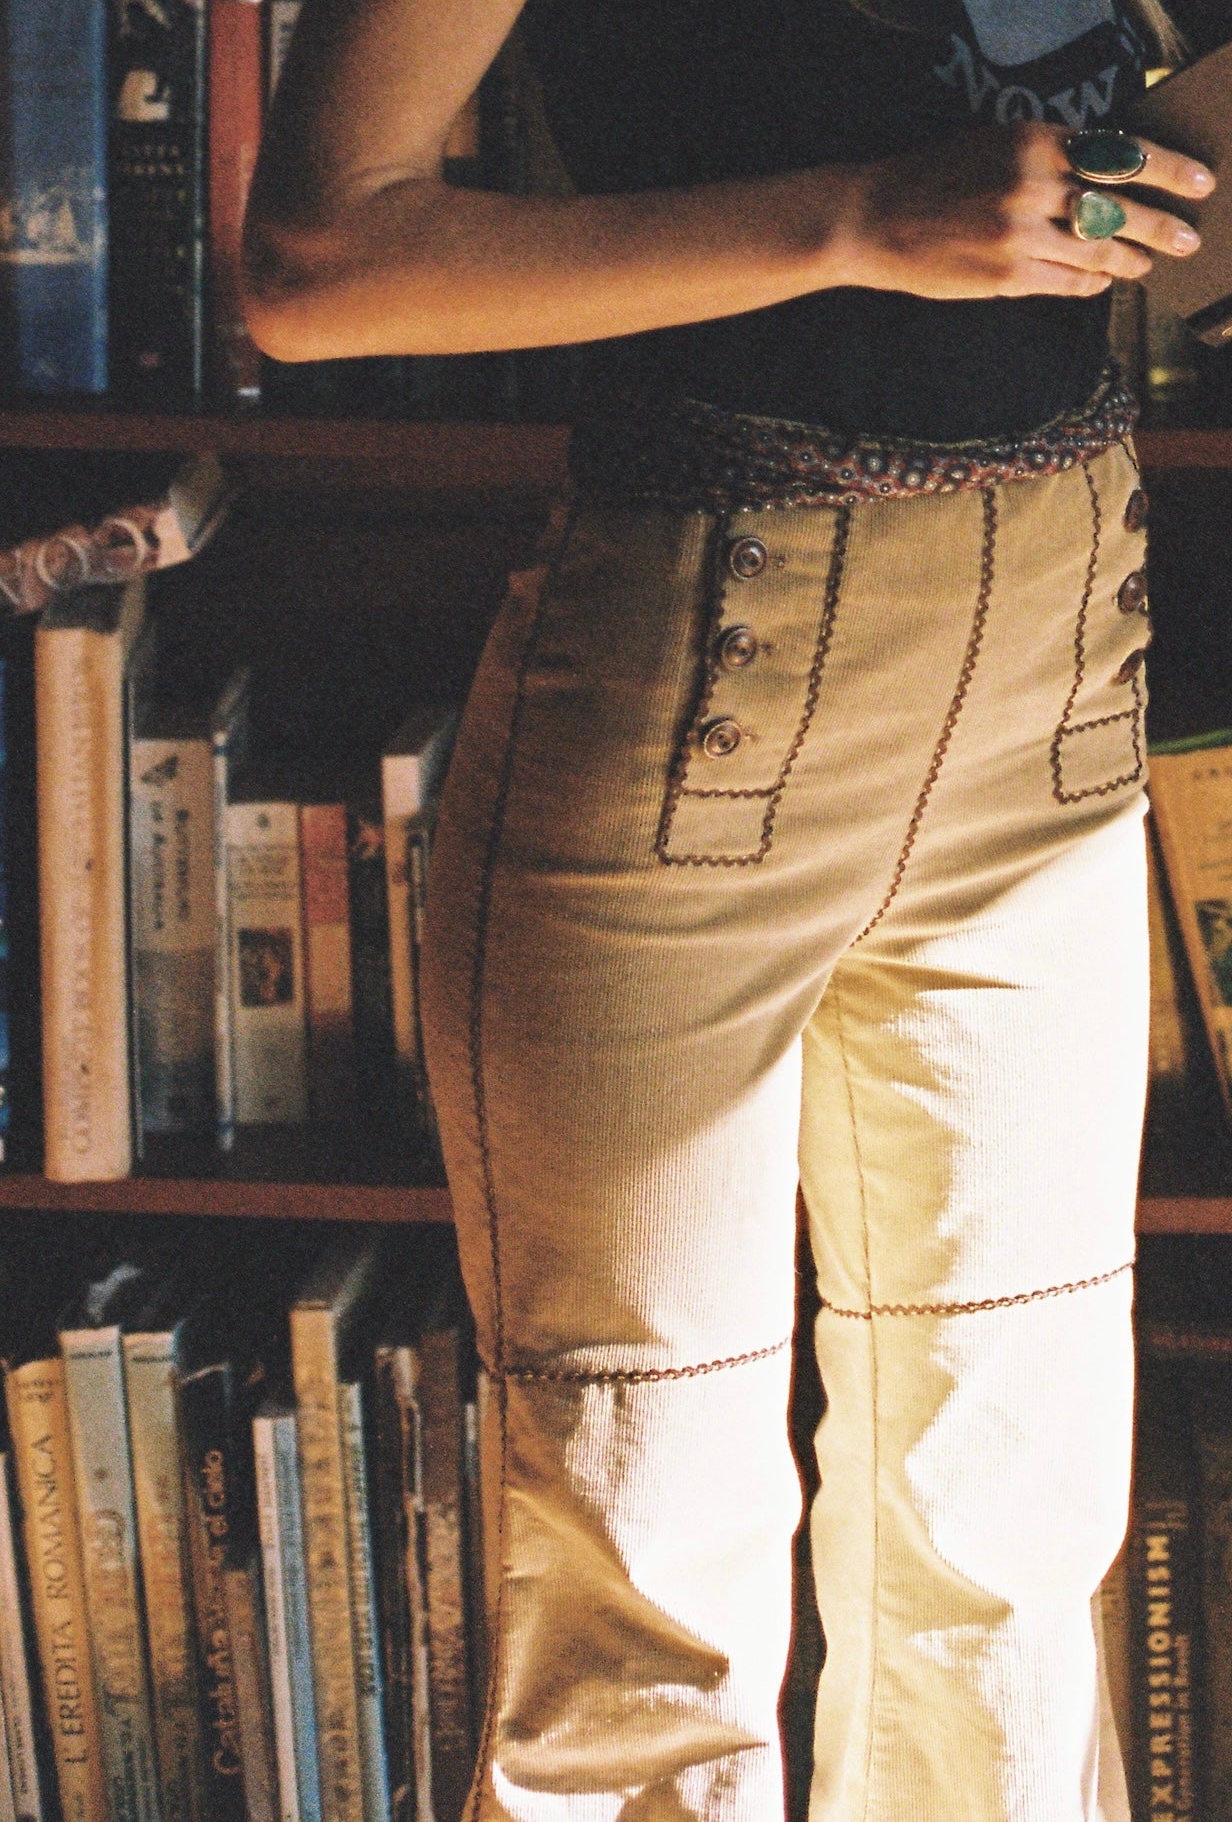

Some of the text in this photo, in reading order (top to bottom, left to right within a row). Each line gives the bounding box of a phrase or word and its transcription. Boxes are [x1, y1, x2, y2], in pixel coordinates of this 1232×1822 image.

[933, 32, 1119, 128] NOW
[30, 1433, 70, 1602] ROMANICA
[200, 1448, 227, 1511] cielo
[1143, 1533, 1175, 1822] EXPRESSIONISM
